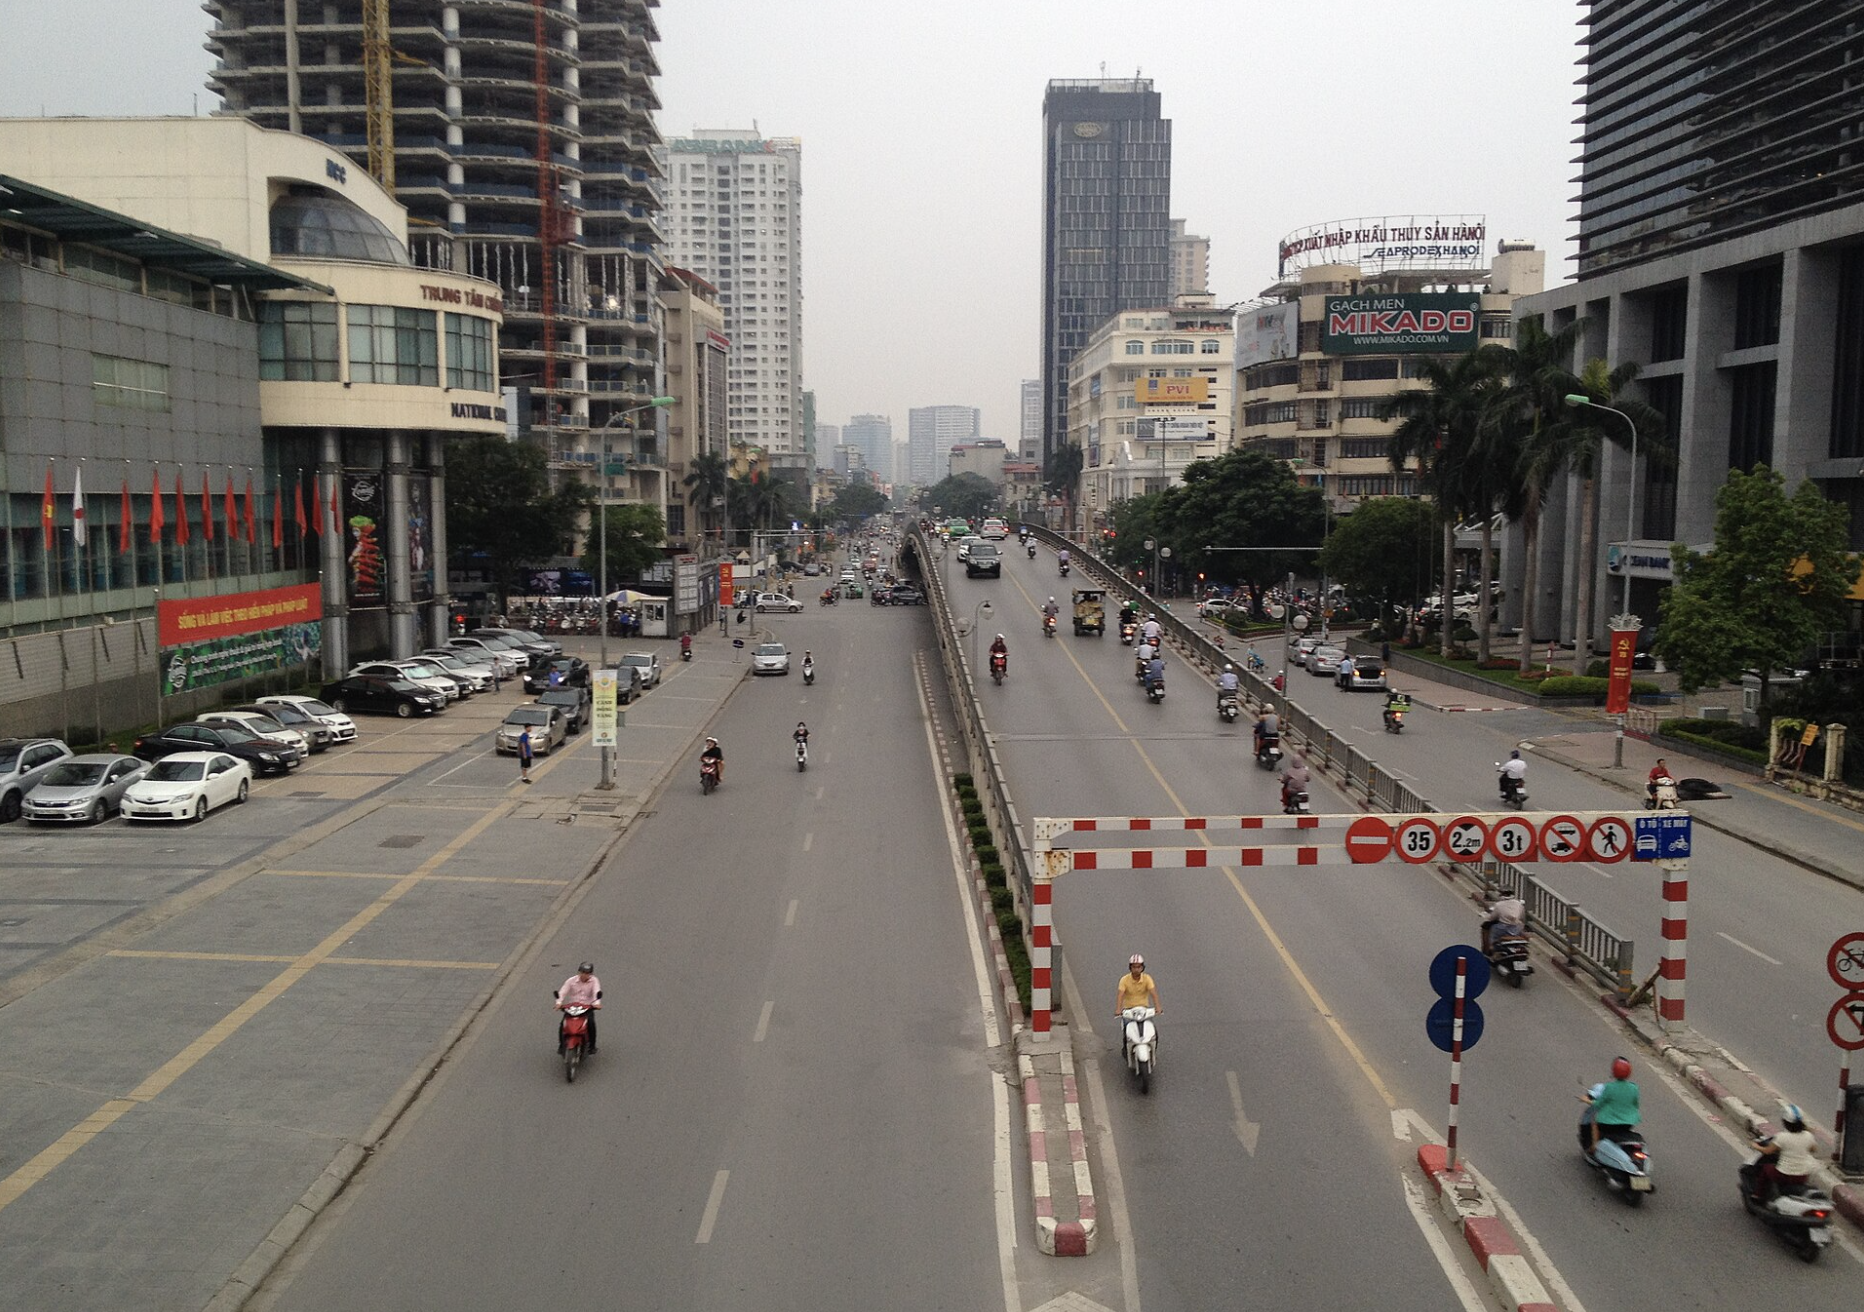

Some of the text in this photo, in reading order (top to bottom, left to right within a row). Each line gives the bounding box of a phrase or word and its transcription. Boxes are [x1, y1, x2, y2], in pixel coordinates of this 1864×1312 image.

[1425, 219, 1449, 241] SẢN
[420, 284, 461, 304] TRUNG
[464, 288, 484, 308] TÂM
[1330, 298, 1405, 314] GẠCH MEN
[1329, 309, 1475, 337] MIKADO
[1353, 334, 1449, 345] WWW.MIKADO.COM.VN
[1166, 385, 1190, 395] PVI
[1408, 831, 1430, 851] 35
